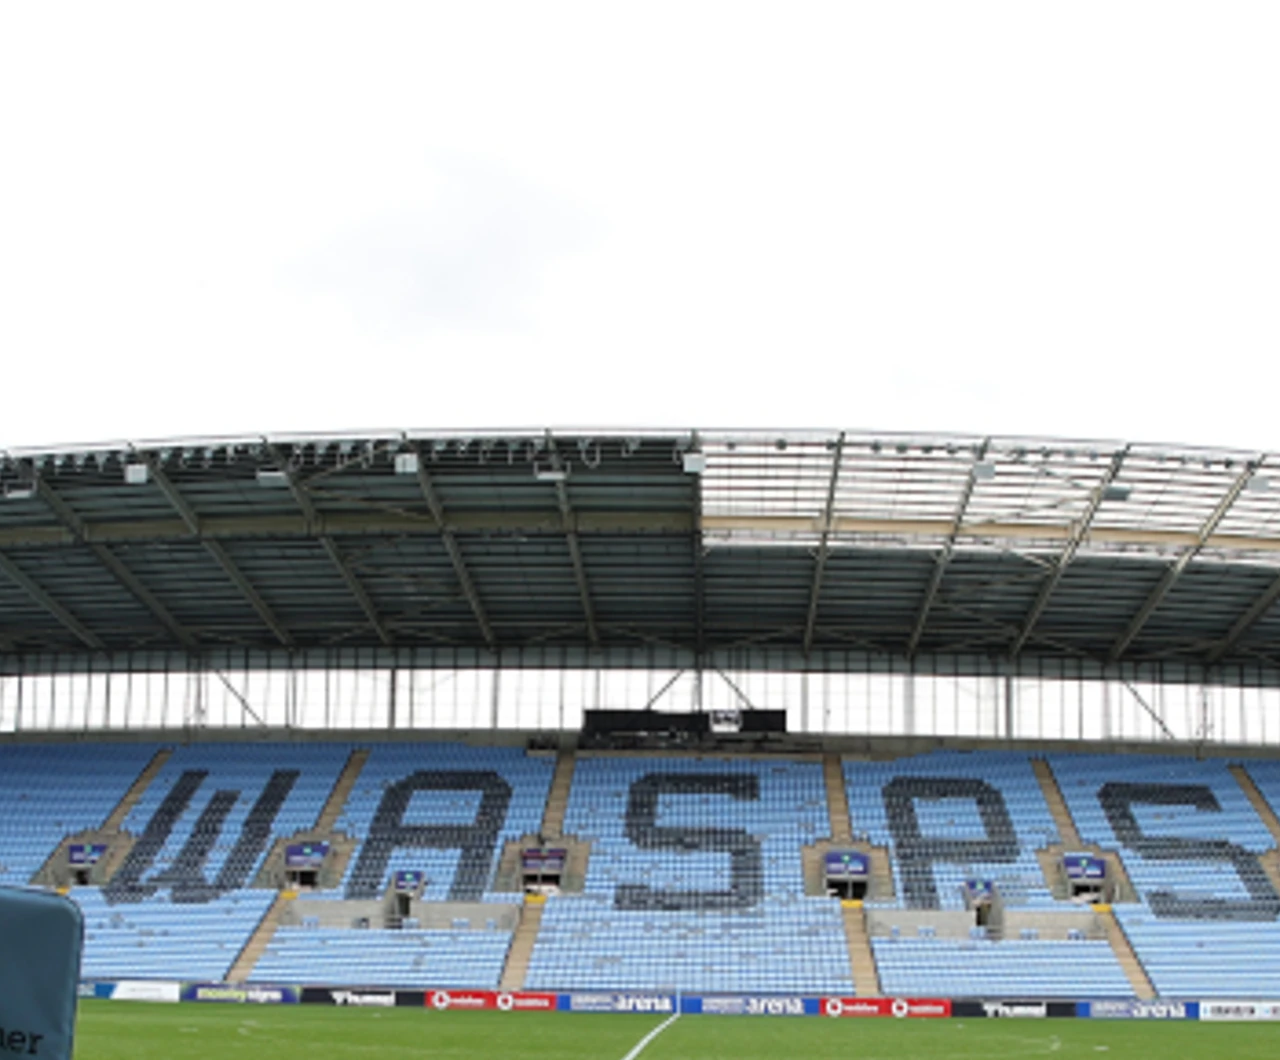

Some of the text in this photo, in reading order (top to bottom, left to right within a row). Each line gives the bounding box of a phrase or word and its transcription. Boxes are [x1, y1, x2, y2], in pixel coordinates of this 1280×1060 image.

[614, 996, 672, 1011] arena
[745, 998, 804, 1014] arena
[1132, 1002, 1186, 1018] arena
